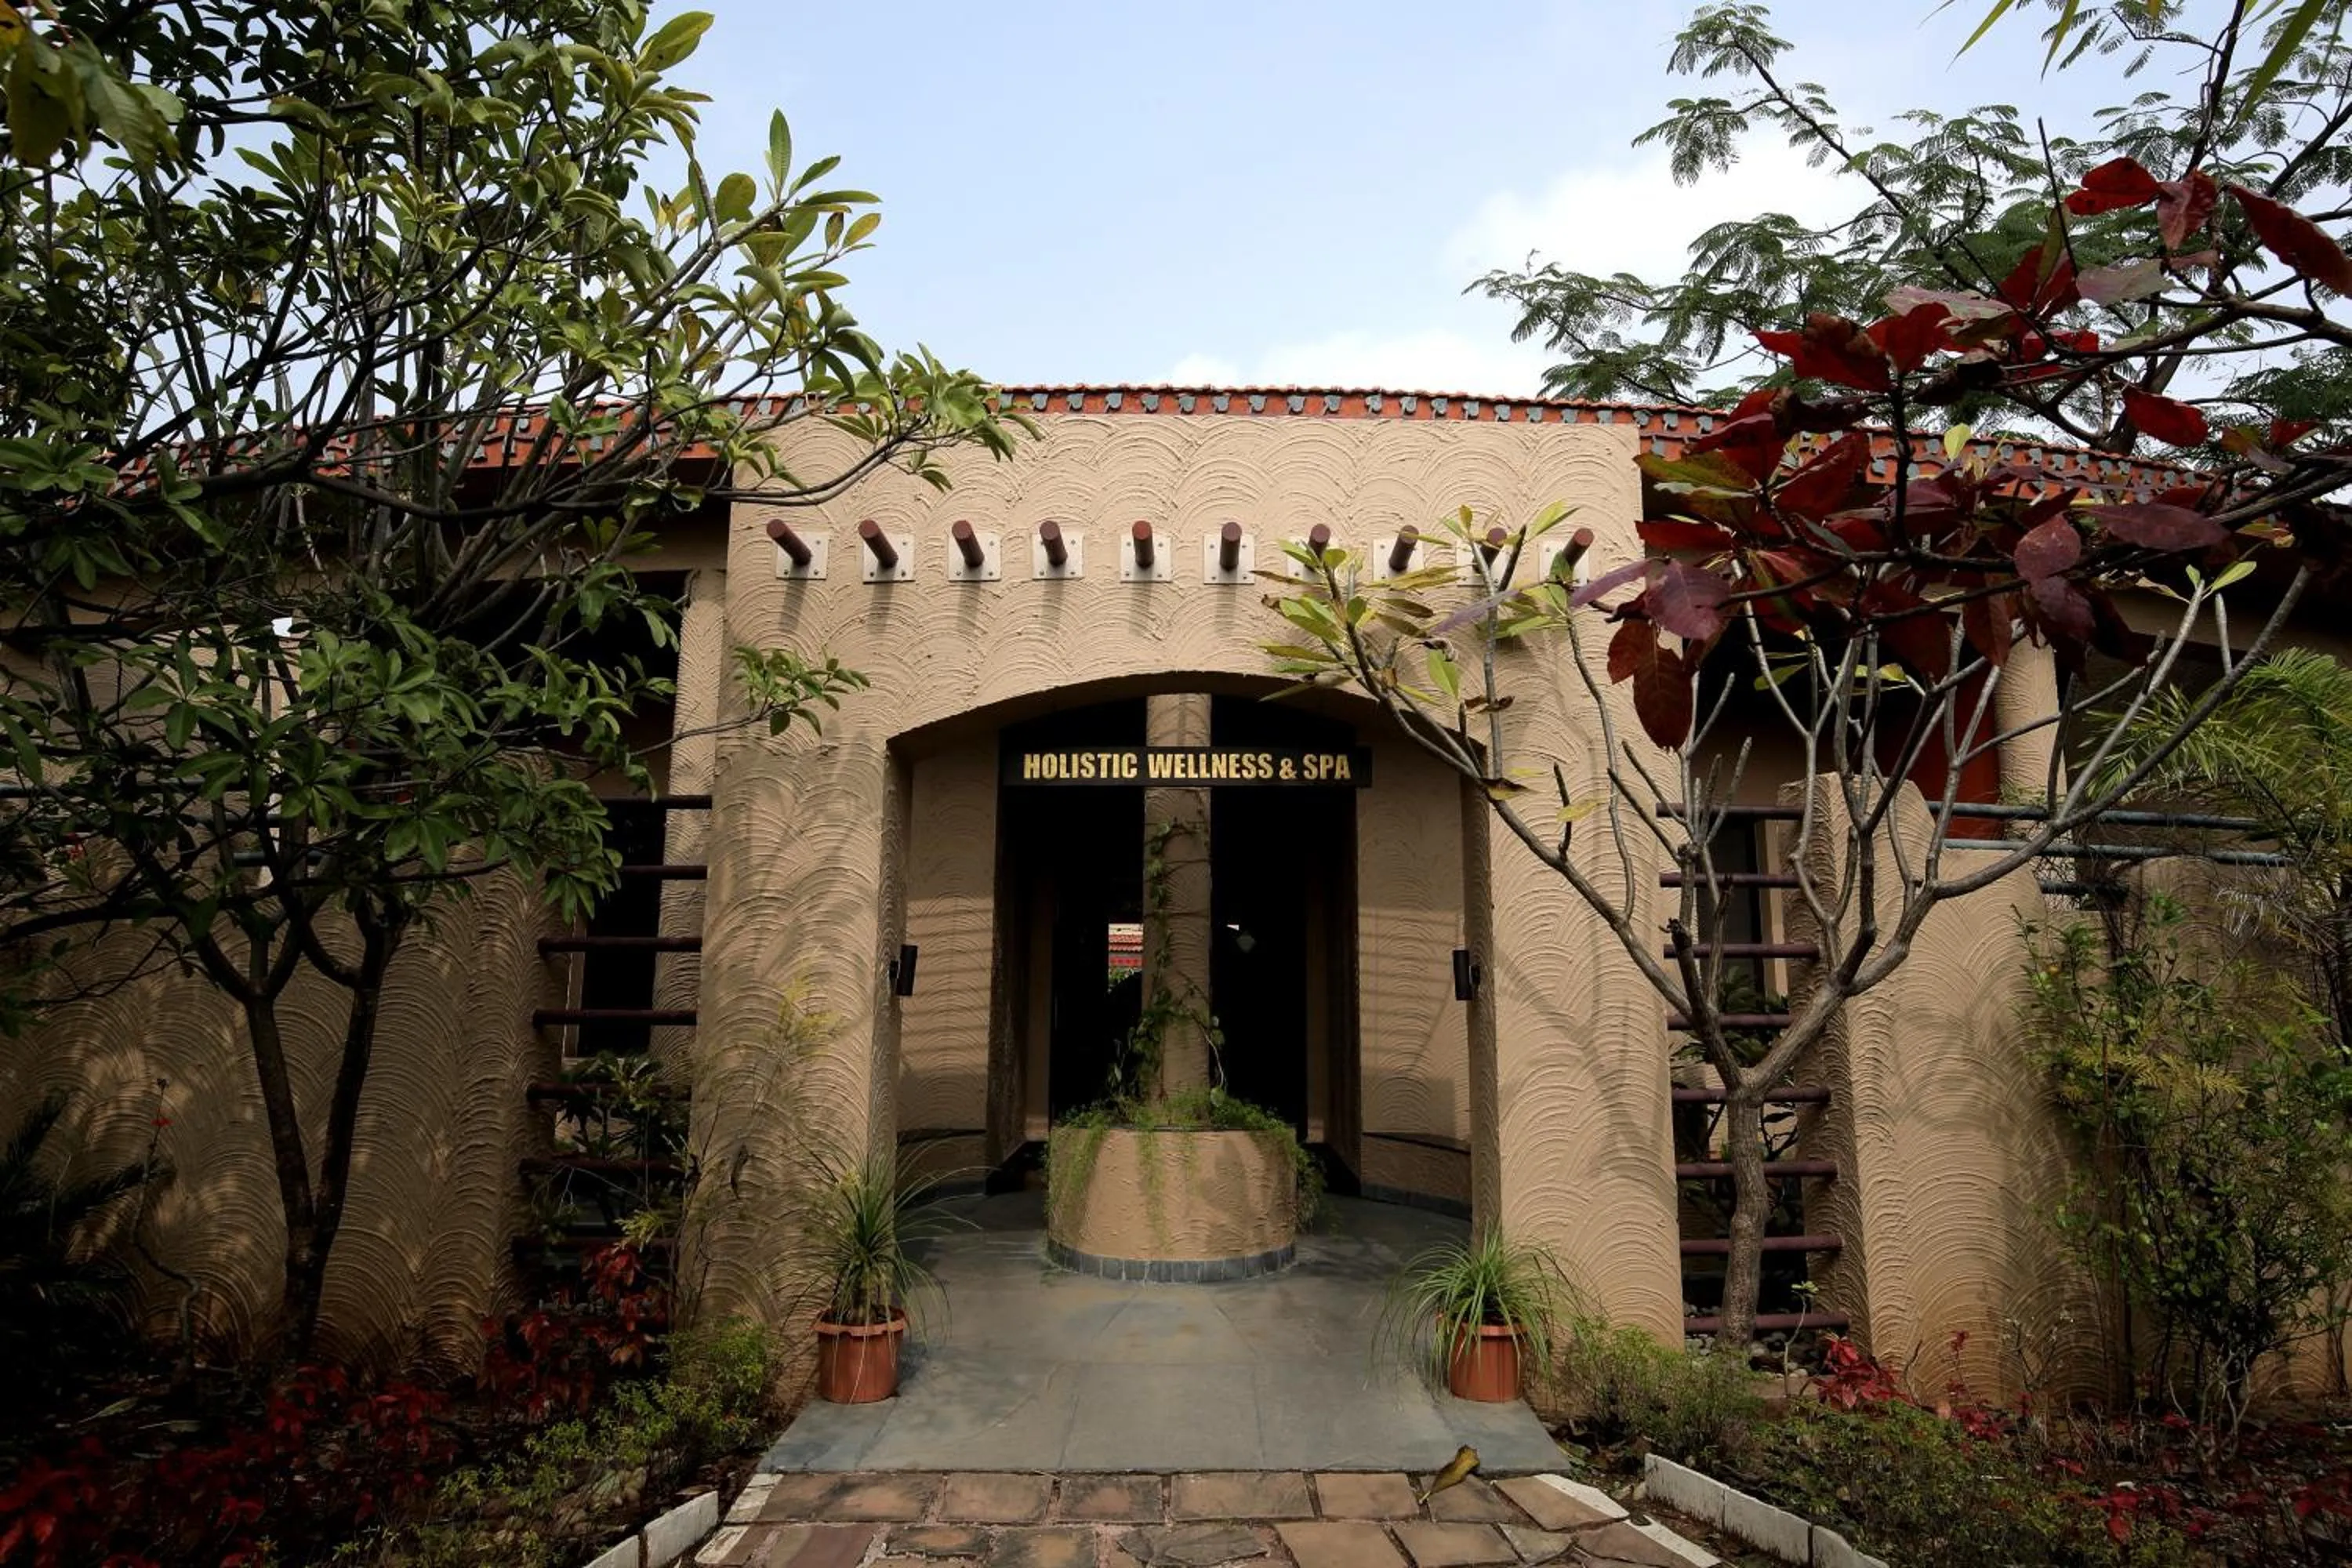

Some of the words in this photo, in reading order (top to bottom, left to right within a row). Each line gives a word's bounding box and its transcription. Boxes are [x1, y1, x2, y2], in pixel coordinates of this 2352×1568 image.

[1023, 753, 1138, 779] HOLISTIC
[1147, 753, 1273, 779] WELLNESS
[1279, 758, 1298, 779] &
[1302, 753, 1351, 780] SPA
